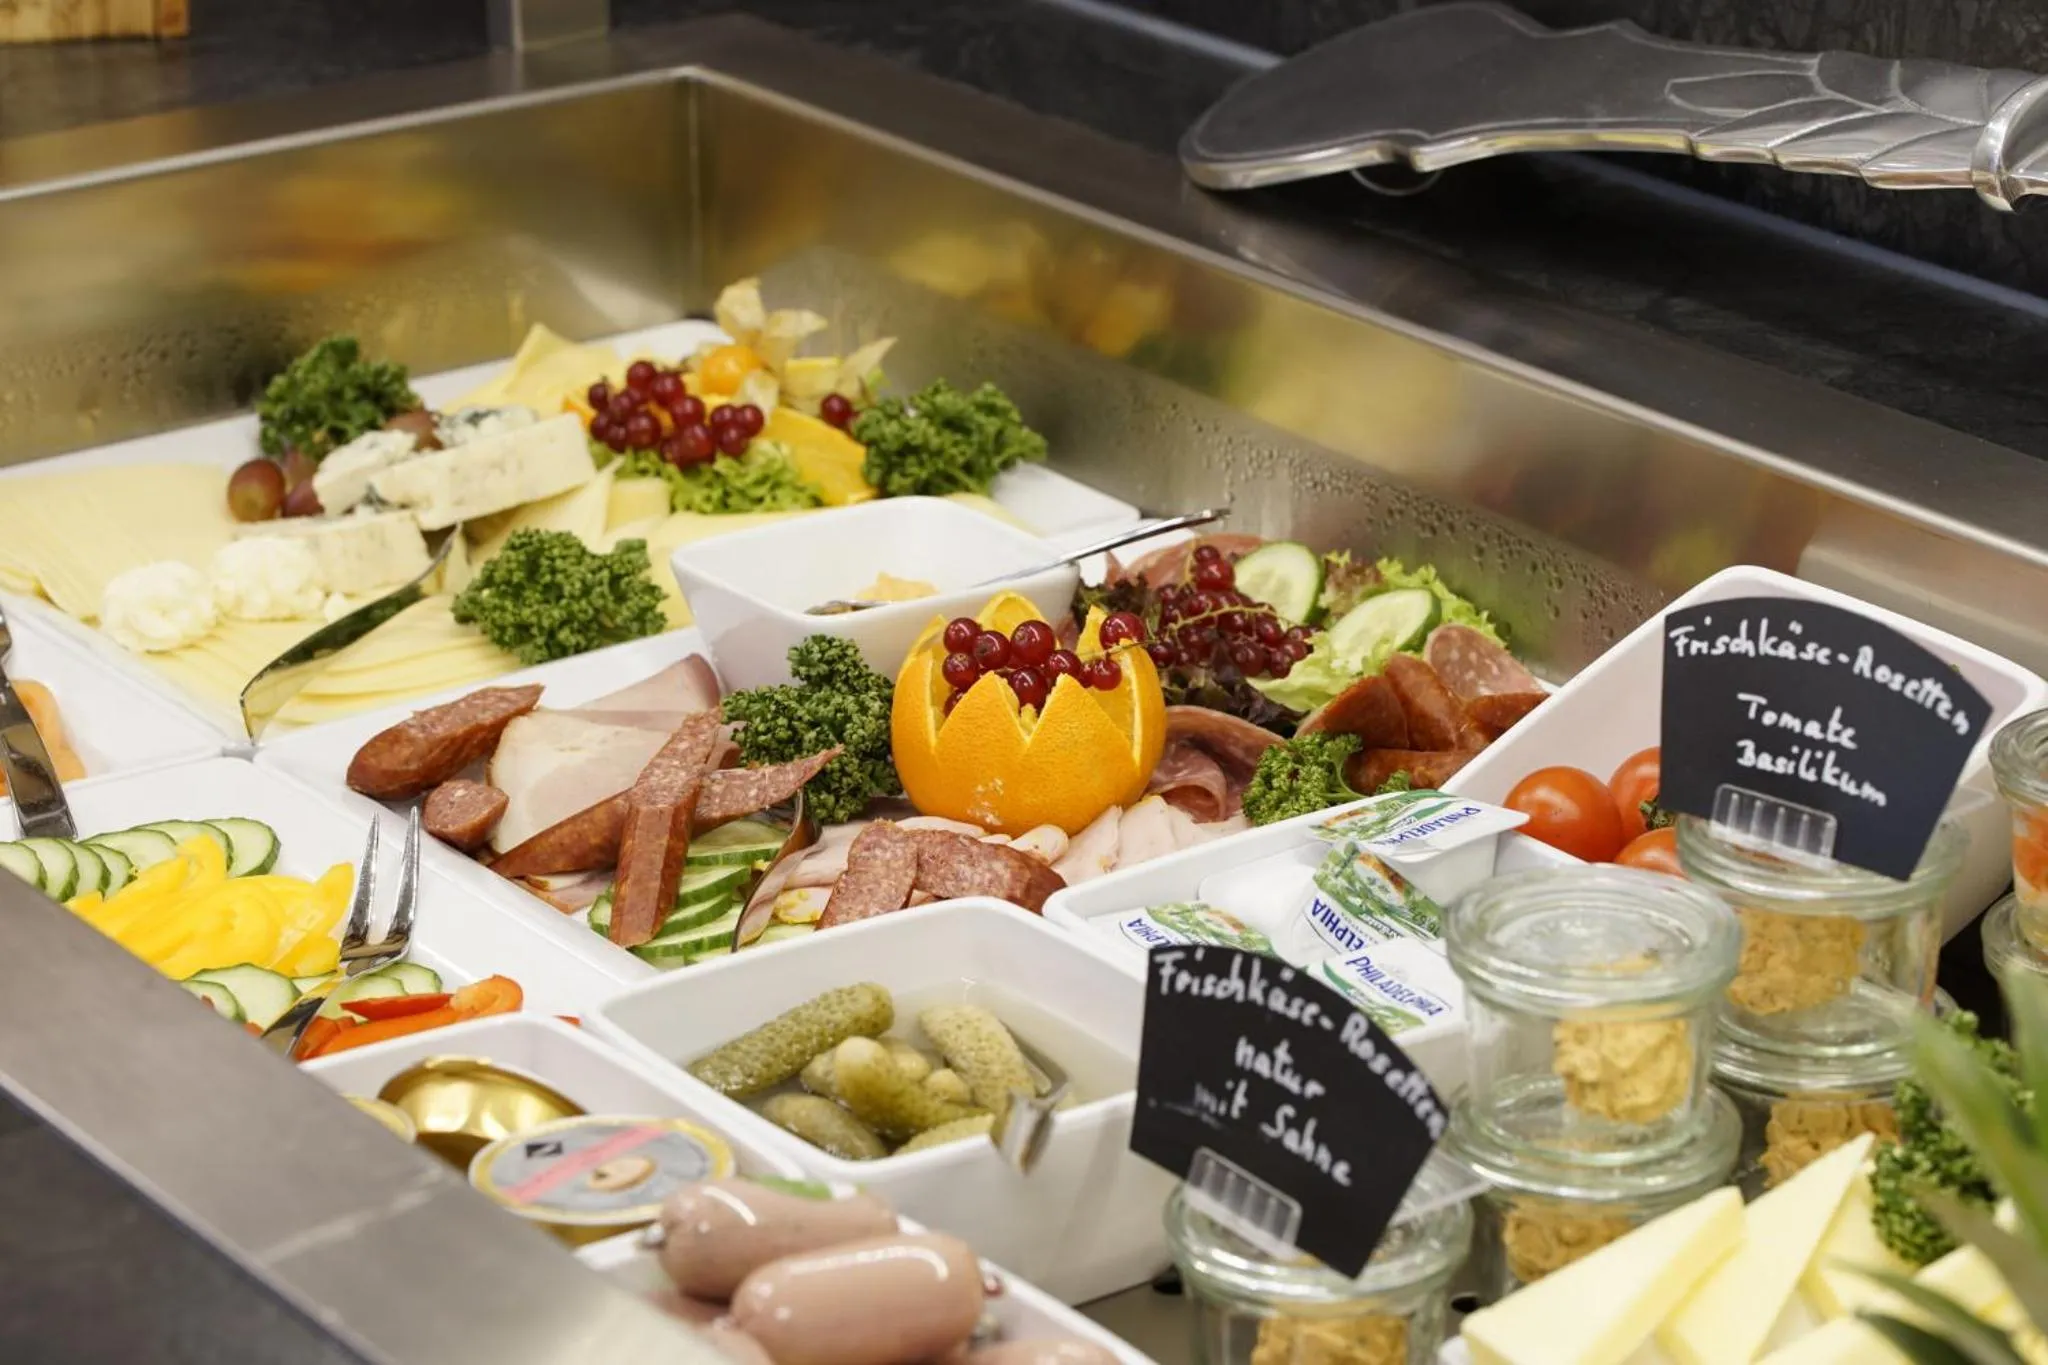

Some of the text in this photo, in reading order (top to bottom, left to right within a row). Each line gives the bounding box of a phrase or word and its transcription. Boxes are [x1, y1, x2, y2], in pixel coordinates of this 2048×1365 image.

[1669, 615, 1971, 736] Frischkäse-Rosetten
[1736, 692, 1858, 750] Tomate
[1736, 739, 1888, 807] Basilikum
[1311, 898, 1365, 952] ELPHIA
[1259, 1103, 1352, 1187] Sahne
